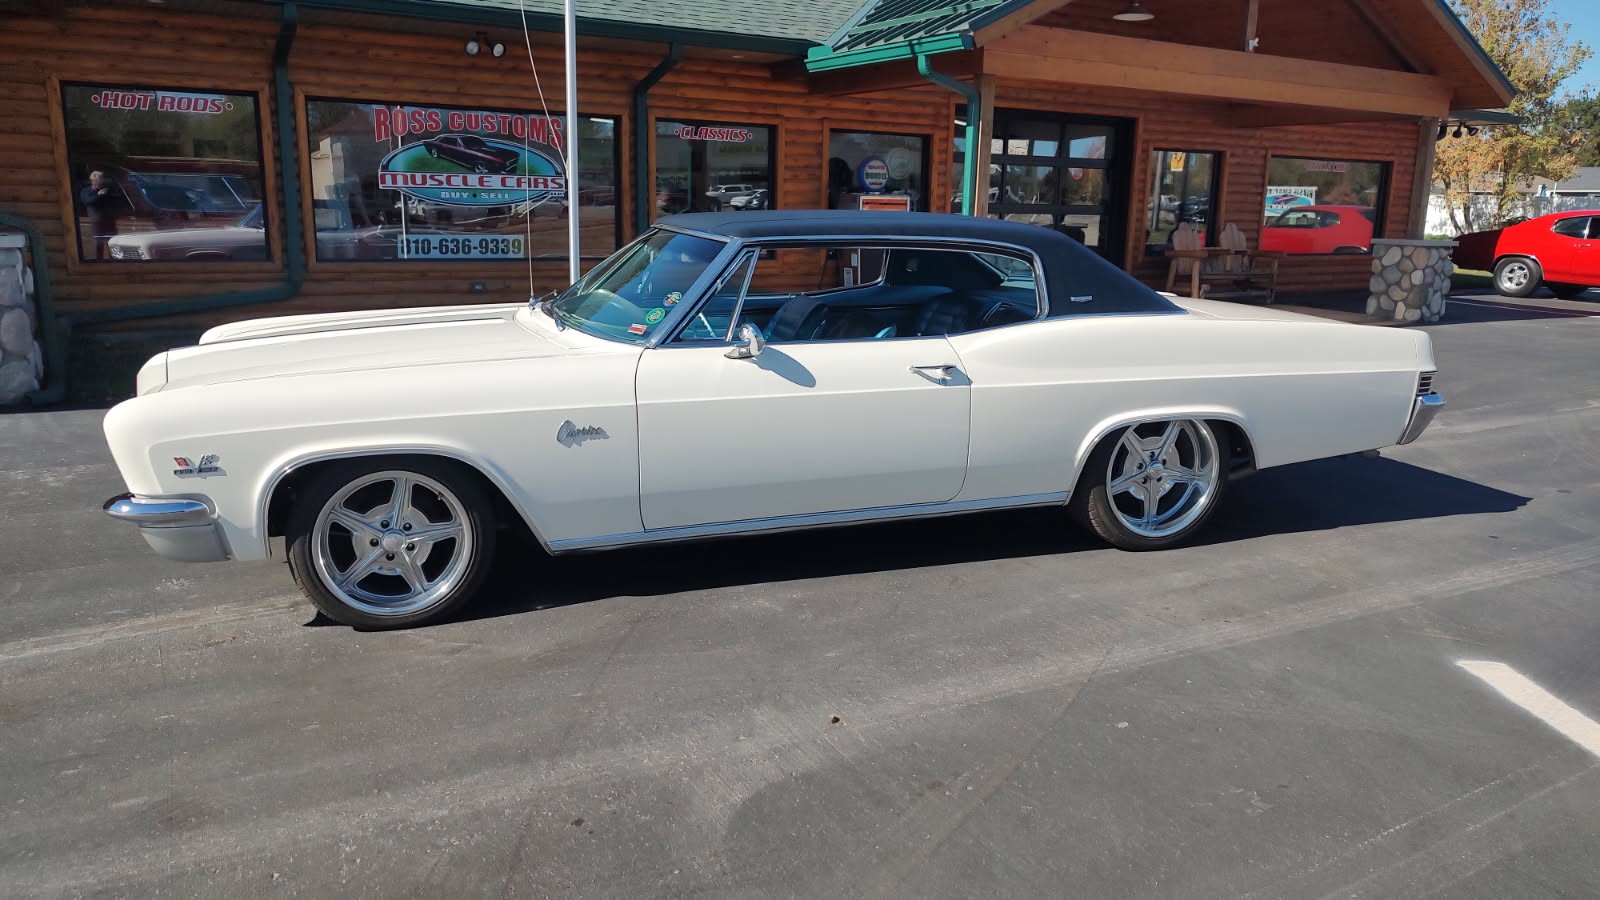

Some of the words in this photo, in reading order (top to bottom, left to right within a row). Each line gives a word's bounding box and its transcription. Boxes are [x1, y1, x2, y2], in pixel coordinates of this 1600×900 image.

[101, 91, 155, 110] HOT
[158, 95, 224, 113] RODS
[374, 108, 442, 142] ROSS
[449, 112, 563, 149] CUSTOMS
[680, 126, 747, 142] CLASSICS
[380, 172, 492, 188] MUSCLE
[500, 176, 564, 189] CARS
[440, 191, 469, 199] BUY
[400, 238, 521, 255] 810-636-9339
